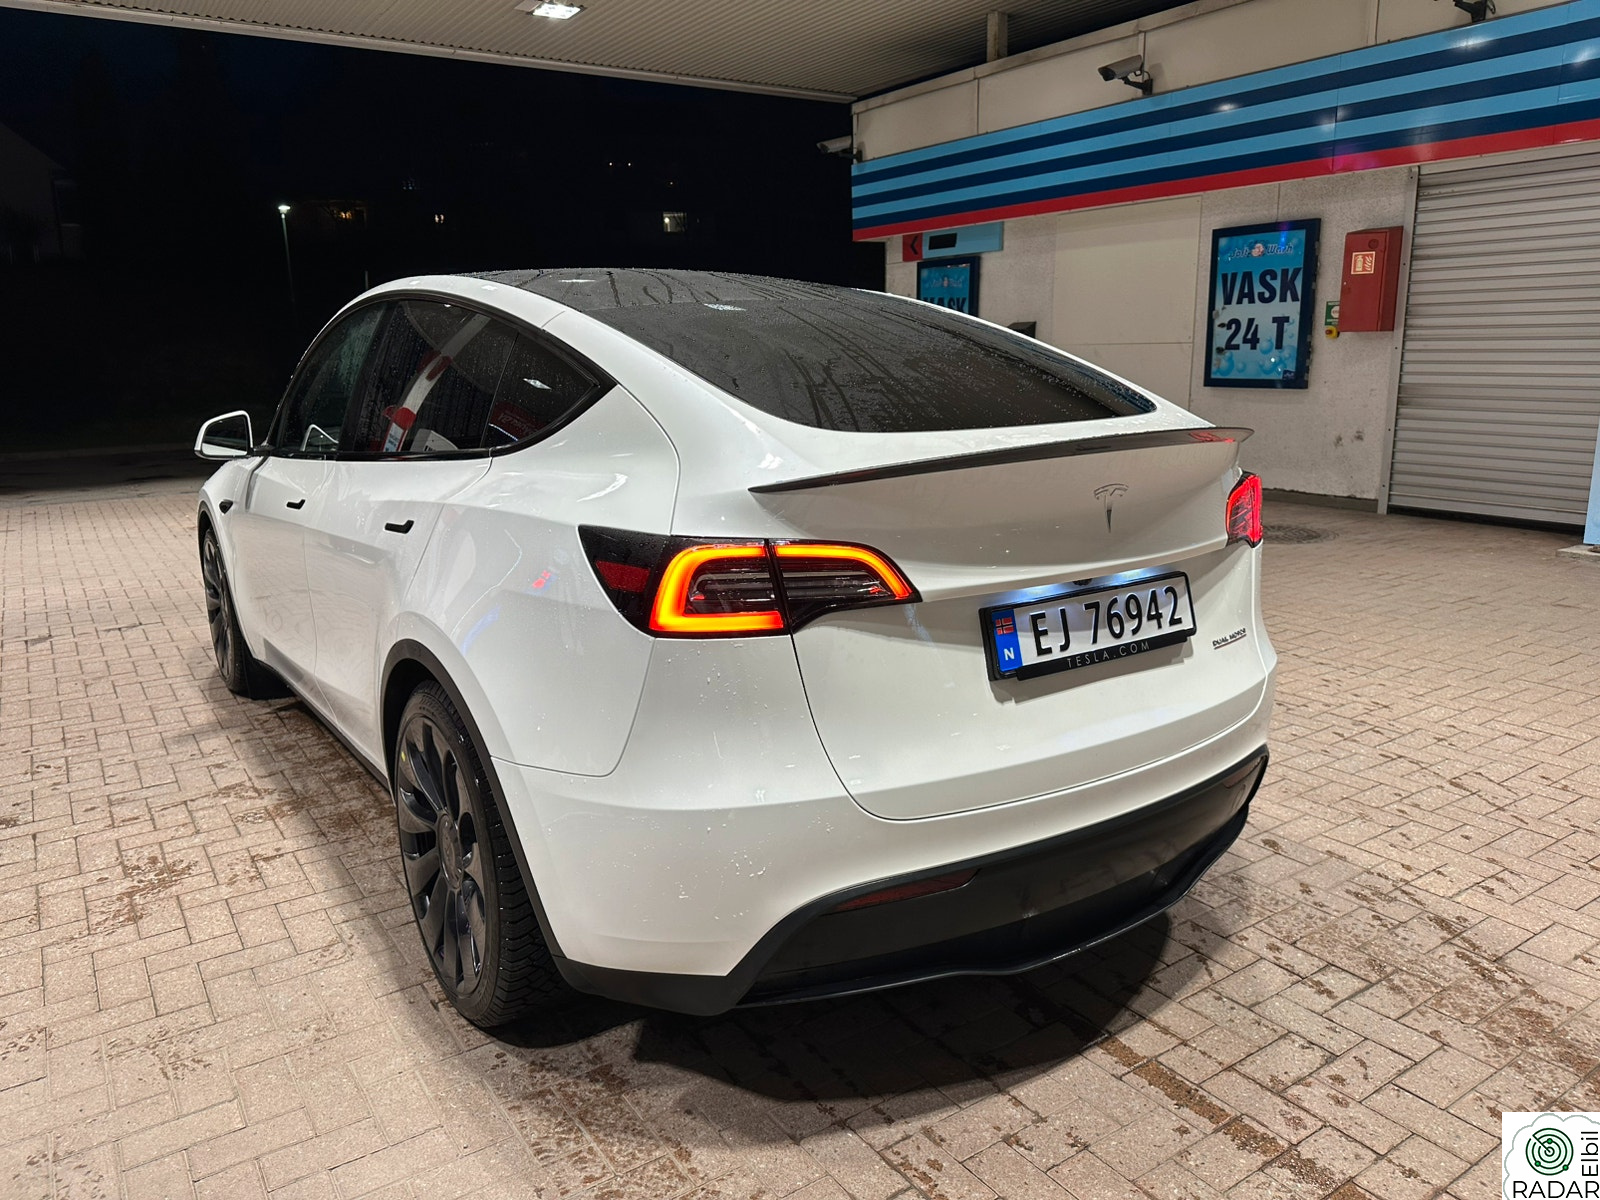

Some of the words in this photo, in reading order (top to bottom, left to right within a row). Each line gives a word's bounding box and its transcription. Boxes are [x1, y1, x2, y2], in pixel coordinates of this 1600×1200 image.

[1221, 267, 1303, 306] VASK
[1225, 317, 1261, 351] 24
[1272, 316, 1290, 350] T
[1030, 607, 1071, 657] EJ
[1083, 586, 1183, 645] 76942
[1003, 647, 1015, 661] N
[1067, 641, 1150, 669] TESLA.COM
